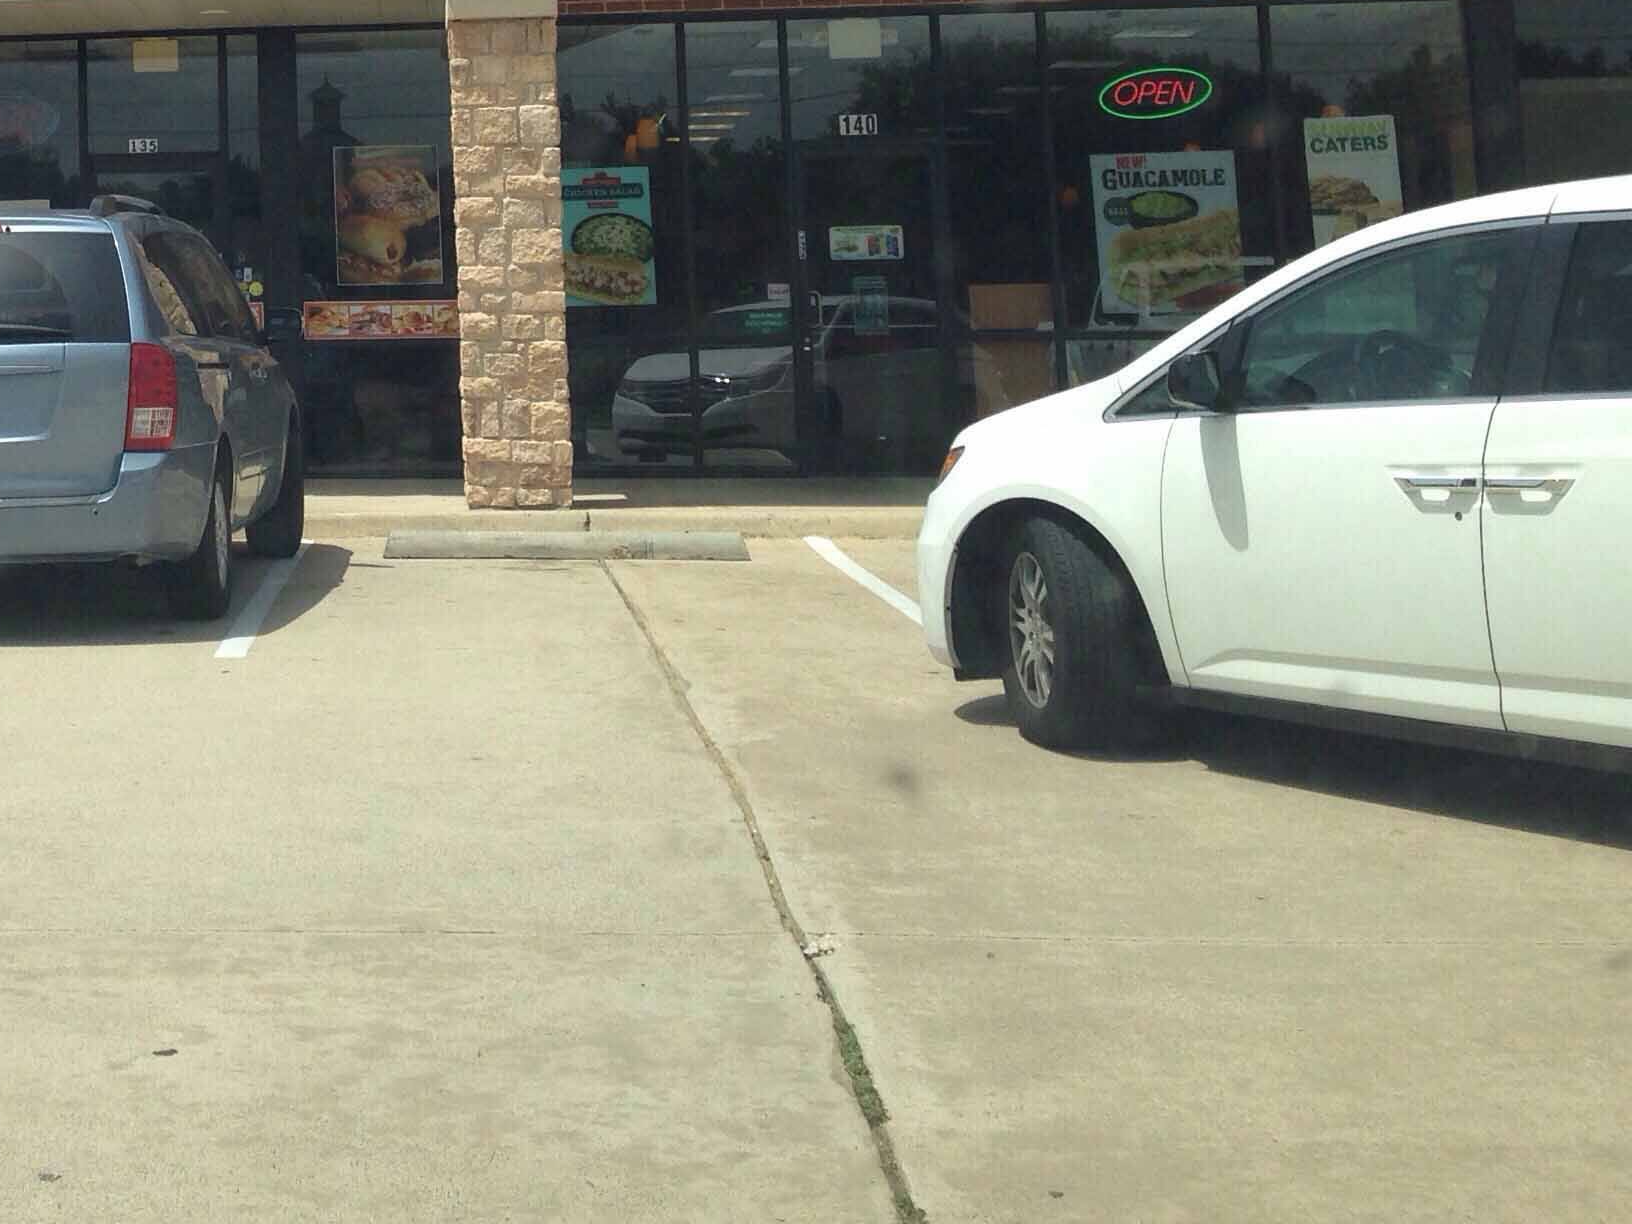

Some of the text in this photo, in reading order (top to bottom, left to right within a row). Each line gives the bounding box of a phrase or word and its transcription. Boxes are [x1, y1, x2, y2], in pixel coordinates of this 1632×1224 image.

[1114, 80, 1196, 106] OPEN
[841, 114, 877, 135] 140
[130, 139, 158, 153] 135
[1310, 134, 1389, 154] CATERS
[1102, 169, 1226, 190] GUACAMOLE
